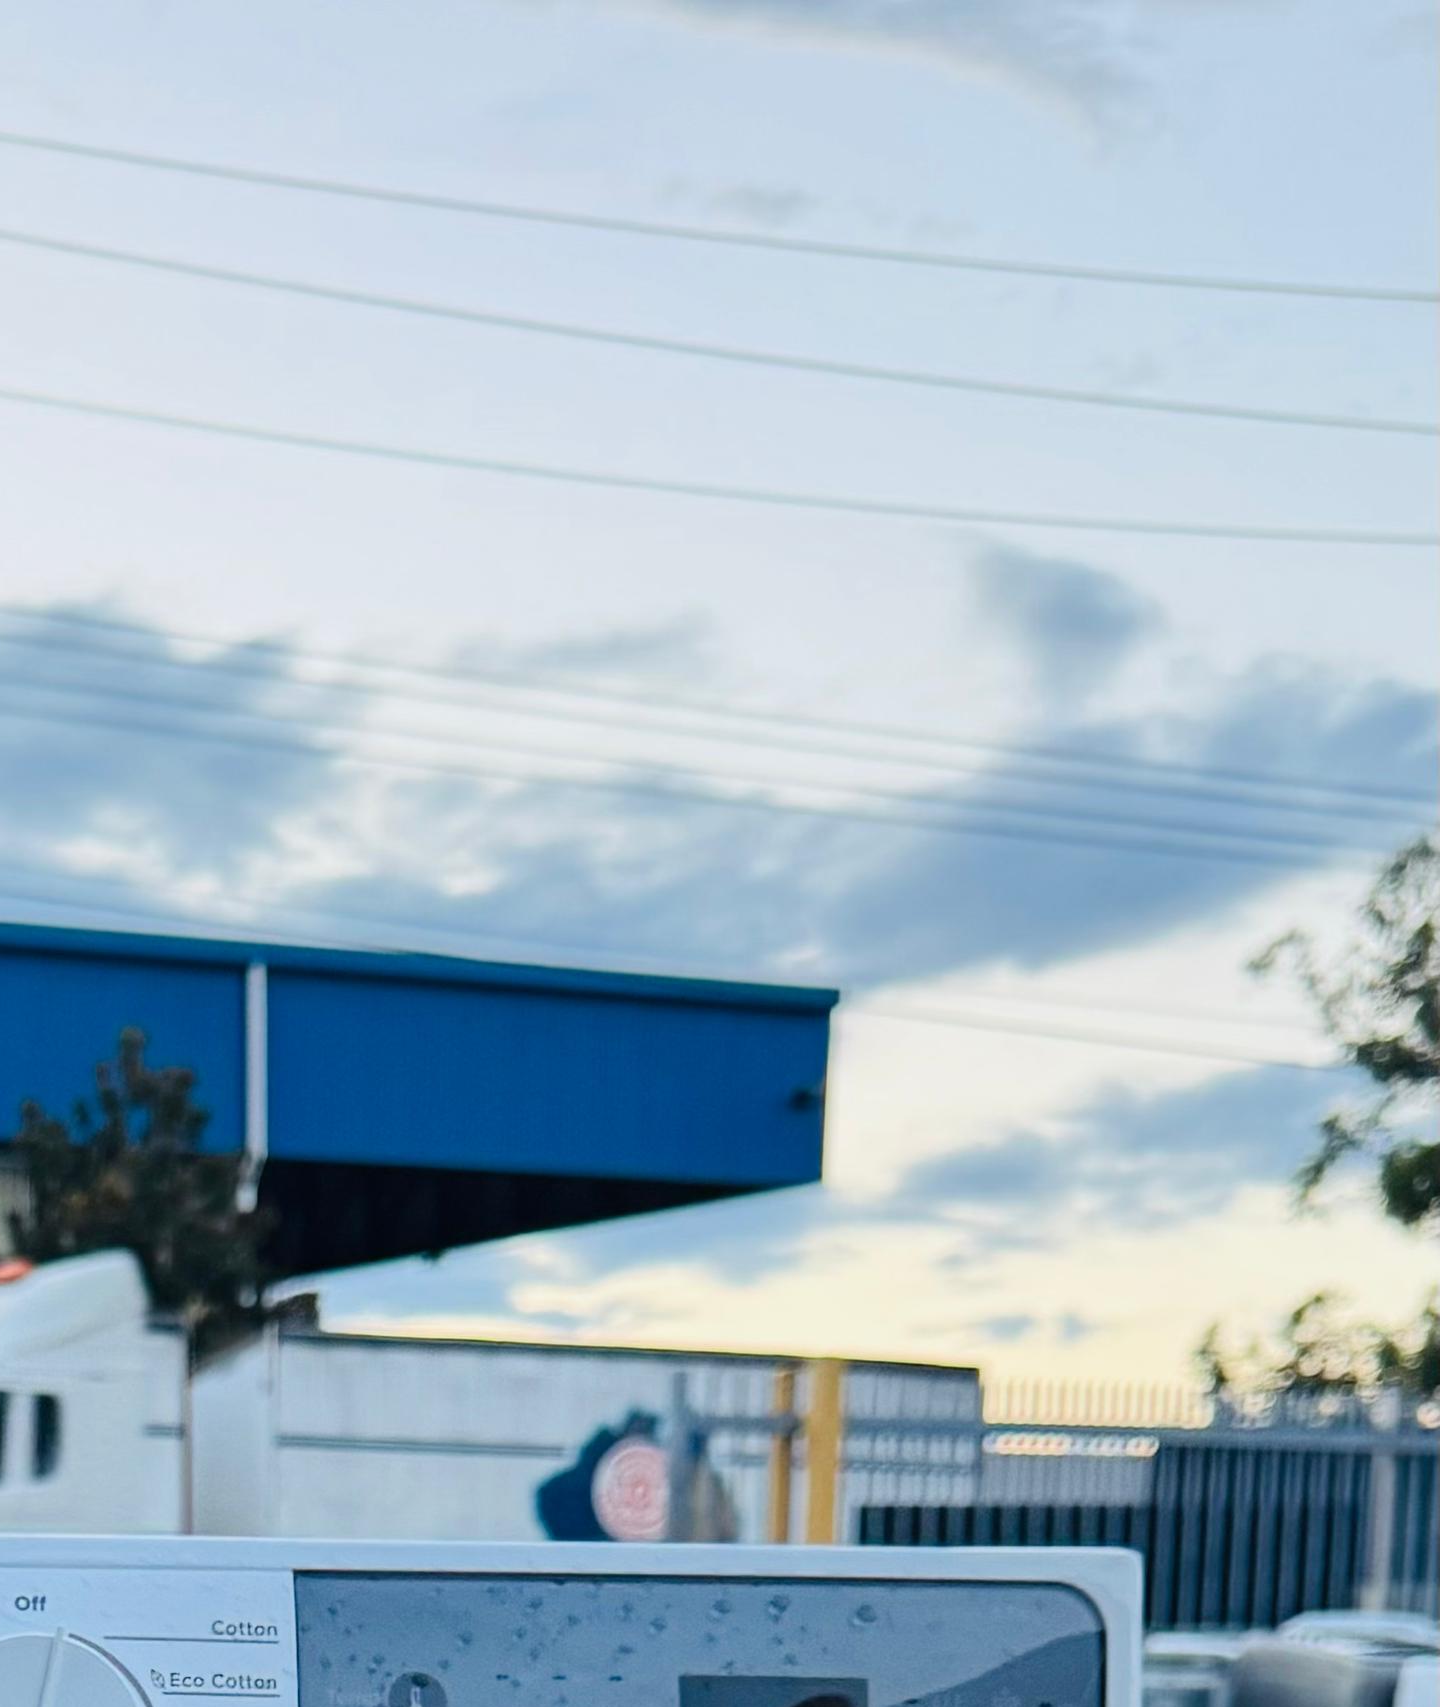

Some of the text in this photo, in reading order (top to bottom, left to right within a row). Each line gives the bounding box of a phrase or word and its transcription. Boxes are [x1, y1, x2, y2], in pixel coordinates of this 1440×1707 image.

[14, 1595, 47, 1612] Off
[211, 1619, 278, 1637] Cotton
[169, 1672, 278, 1690] Eco Cotton
